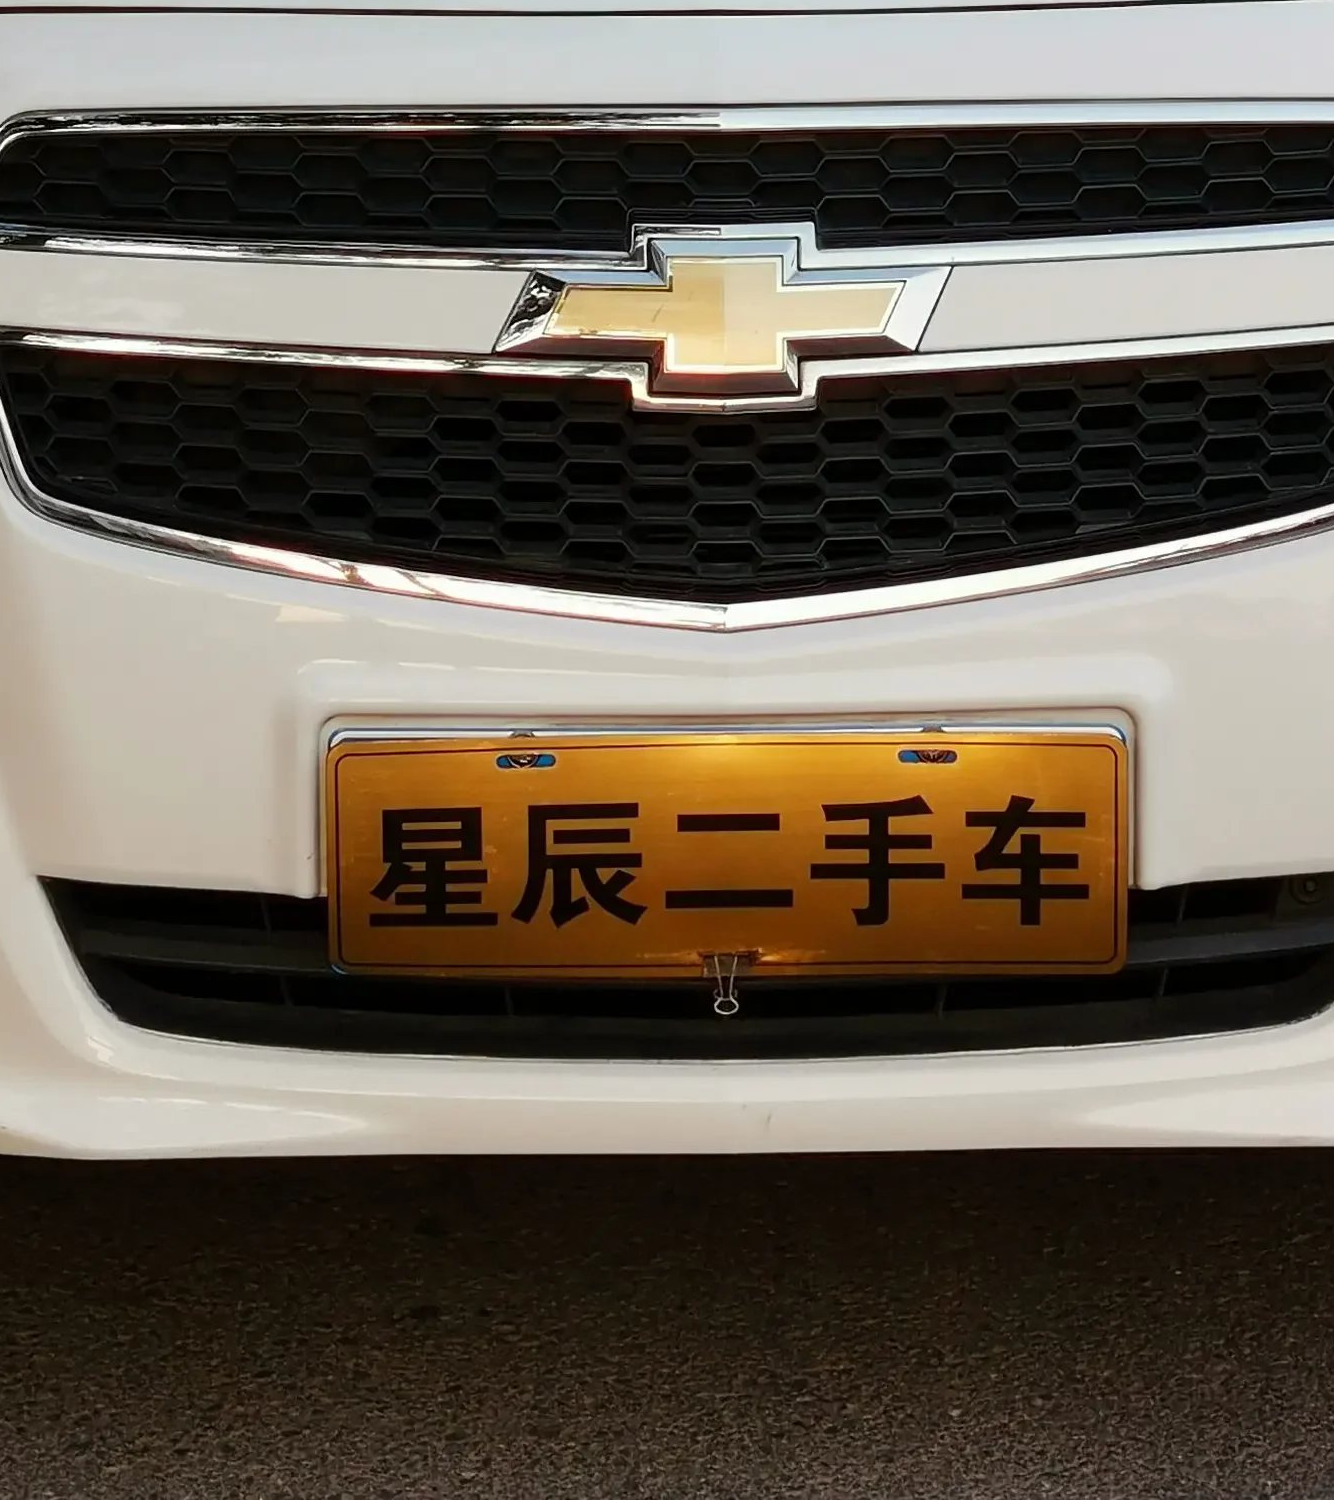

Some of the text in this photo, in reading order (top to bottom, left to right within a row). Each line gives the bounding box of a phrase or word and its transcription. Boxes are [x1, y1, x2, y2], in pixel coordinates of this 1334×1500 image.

[368, 795, 1091, 929] 星辰二手车
